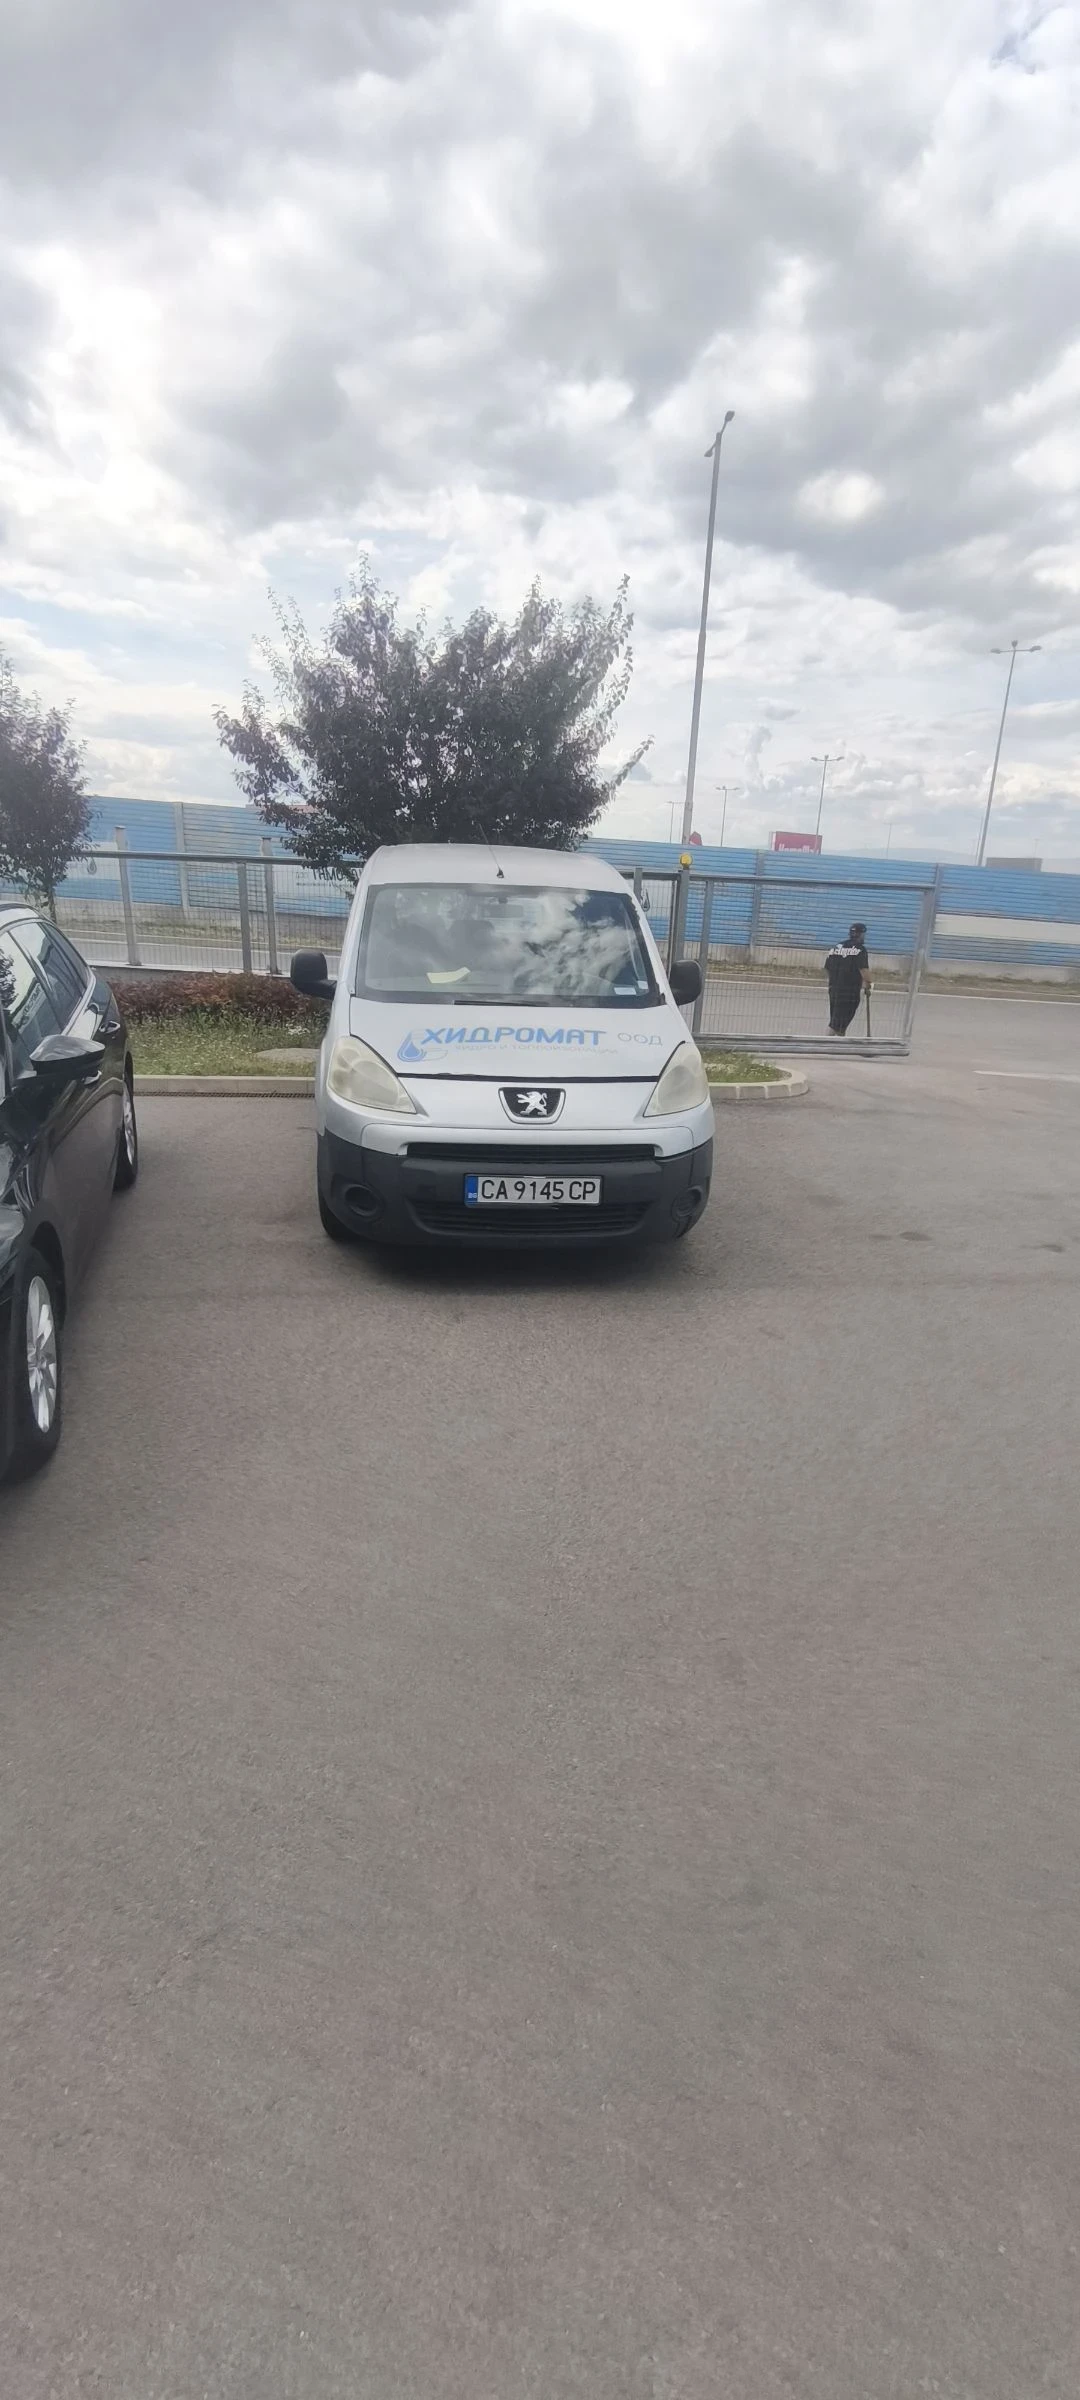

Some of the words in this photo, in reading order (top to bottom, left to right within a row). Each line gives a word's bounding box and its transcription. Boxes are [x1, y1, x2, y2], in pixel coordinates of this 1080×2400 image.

[421, 1027, 606, 1046] ХИДРОМАТ
[617, 1032, 663, 1047] ООД
[514, 1180, 564, 1200] 9145
